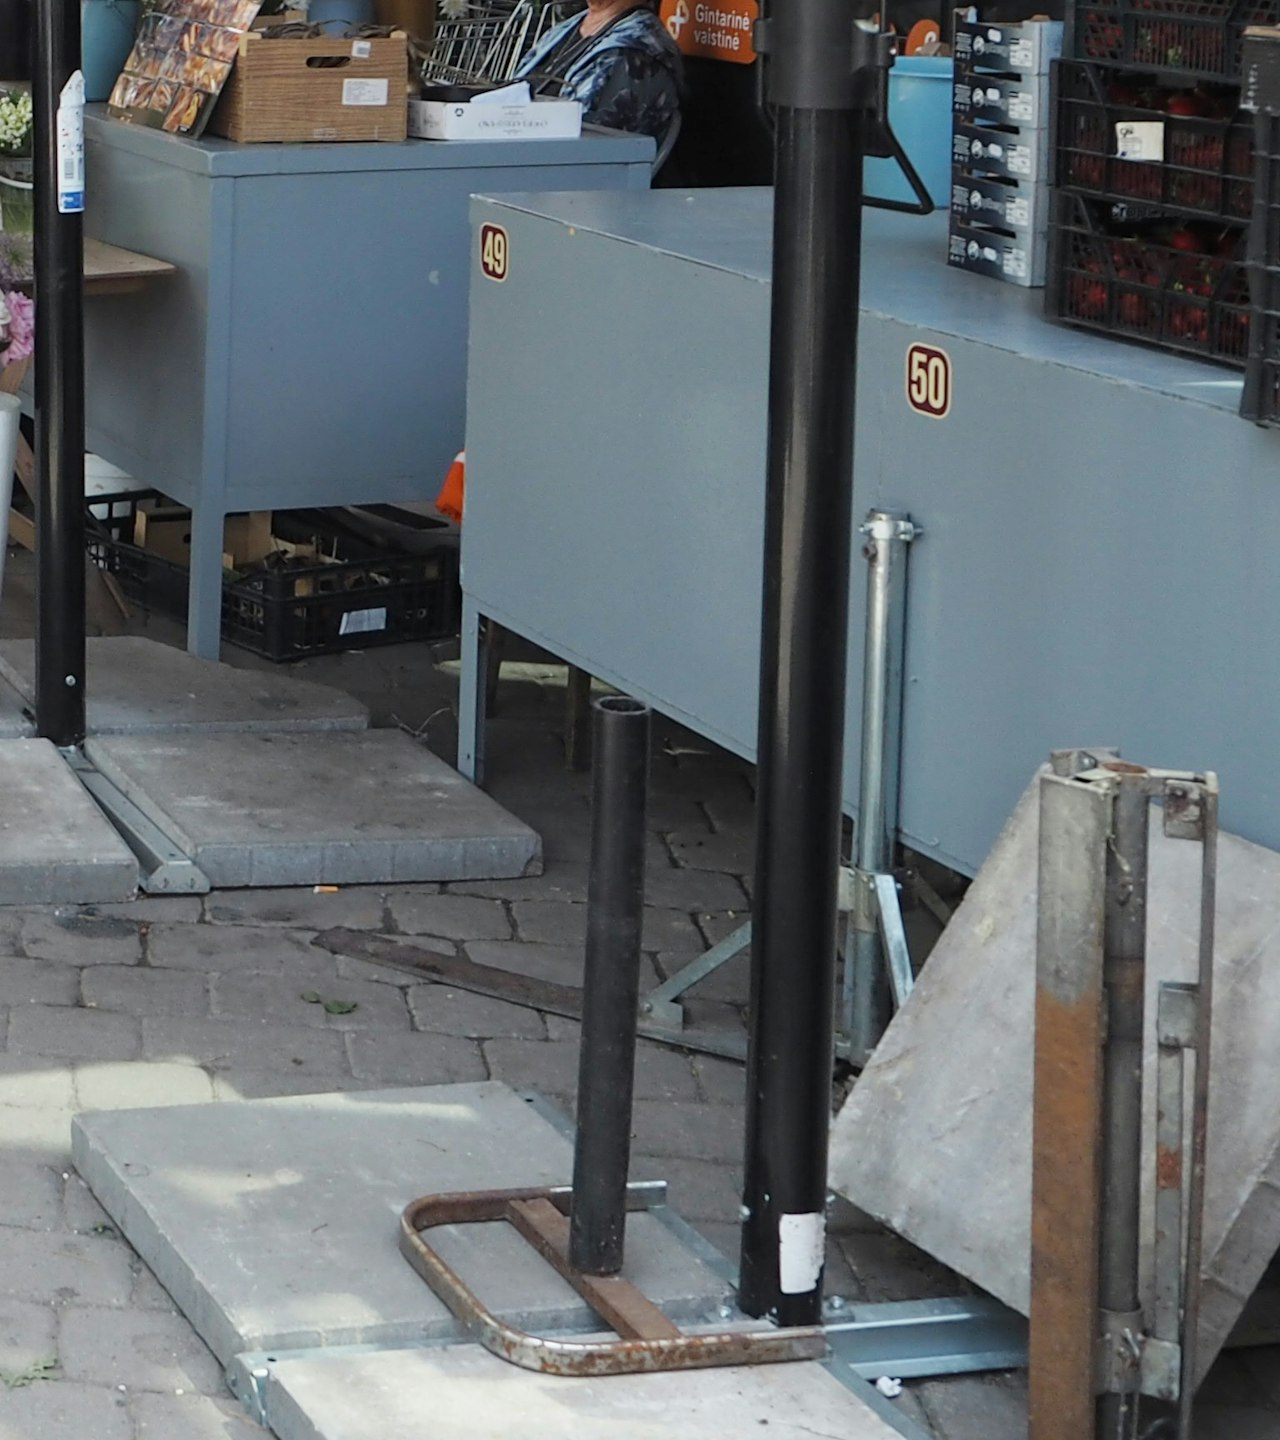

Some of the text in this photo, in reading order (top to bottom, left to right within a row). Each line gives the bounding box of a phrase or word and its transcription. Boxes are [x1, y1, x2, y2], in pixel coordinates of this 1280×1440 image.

[695, 3, 750, 31] Gintarinė
[694, 27, 740, 51] vaistinė
[483, 231, 506, 275] 49
[911, 351, 946, 410] 50
